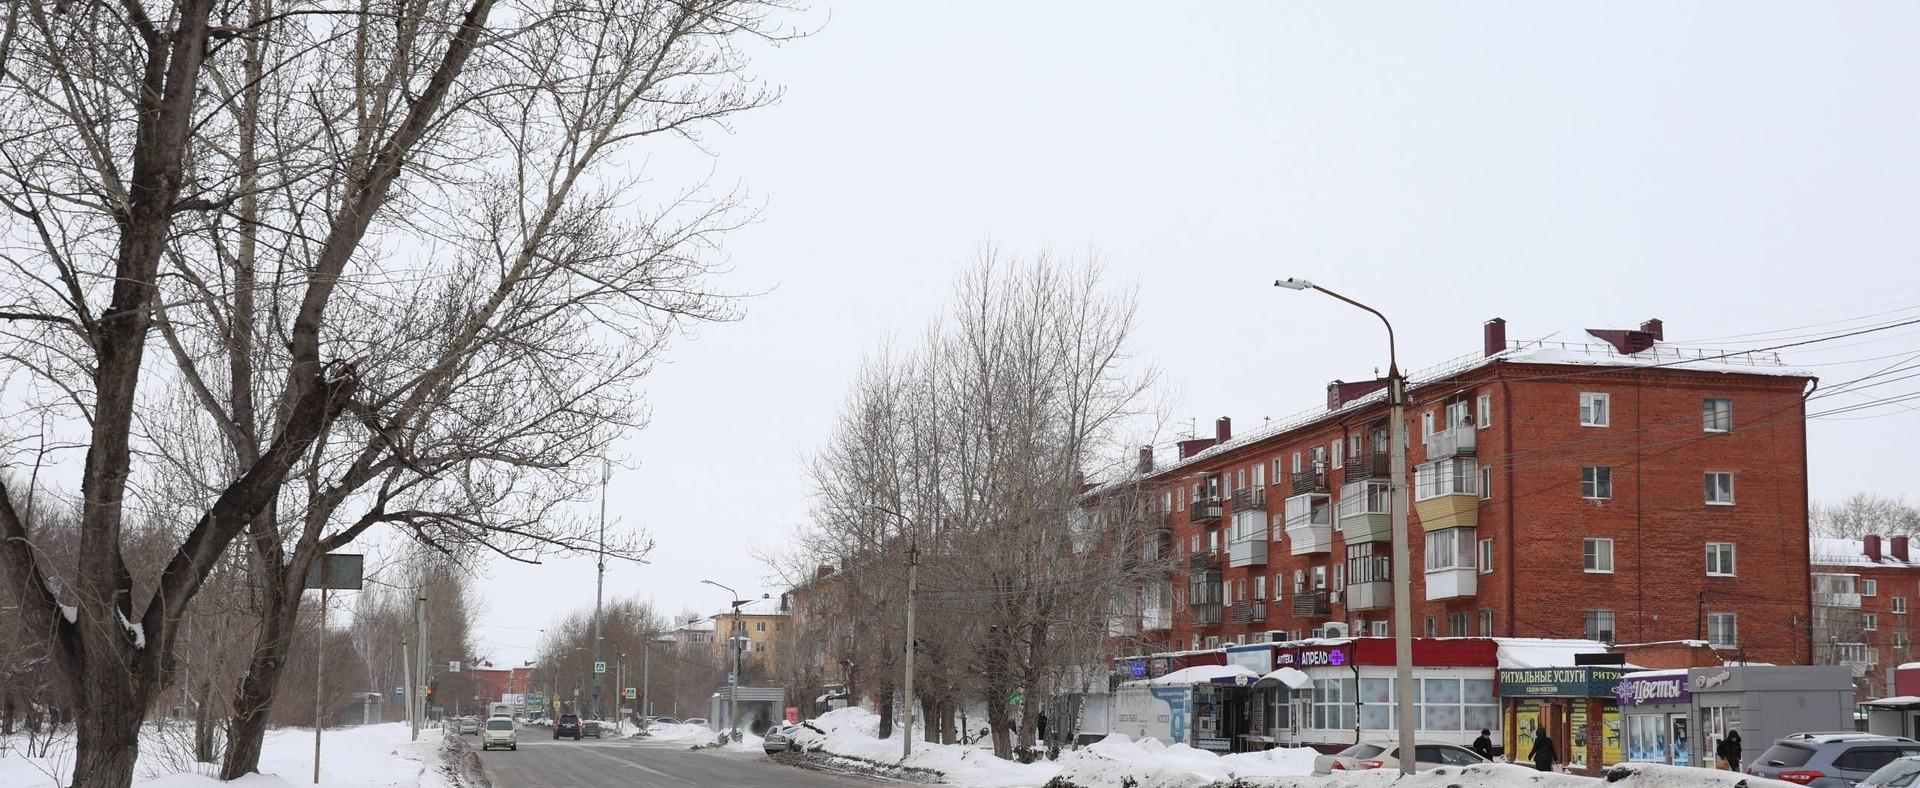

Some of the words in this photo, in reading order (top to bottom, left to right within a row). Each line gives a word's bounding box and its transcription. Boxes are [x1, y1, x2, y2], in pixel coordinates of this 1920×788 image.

[1301, 651, 1328, 666] АПРЕЛЬ
[1500, 670, 1552, 683] РИТУАЛЬНЫЕ
[1553, 669, 1586, 683] УСЛУГИ
[1592, 671, 1622, 680] РИТУА
[1632, 679, 1681, 705] Цветы
